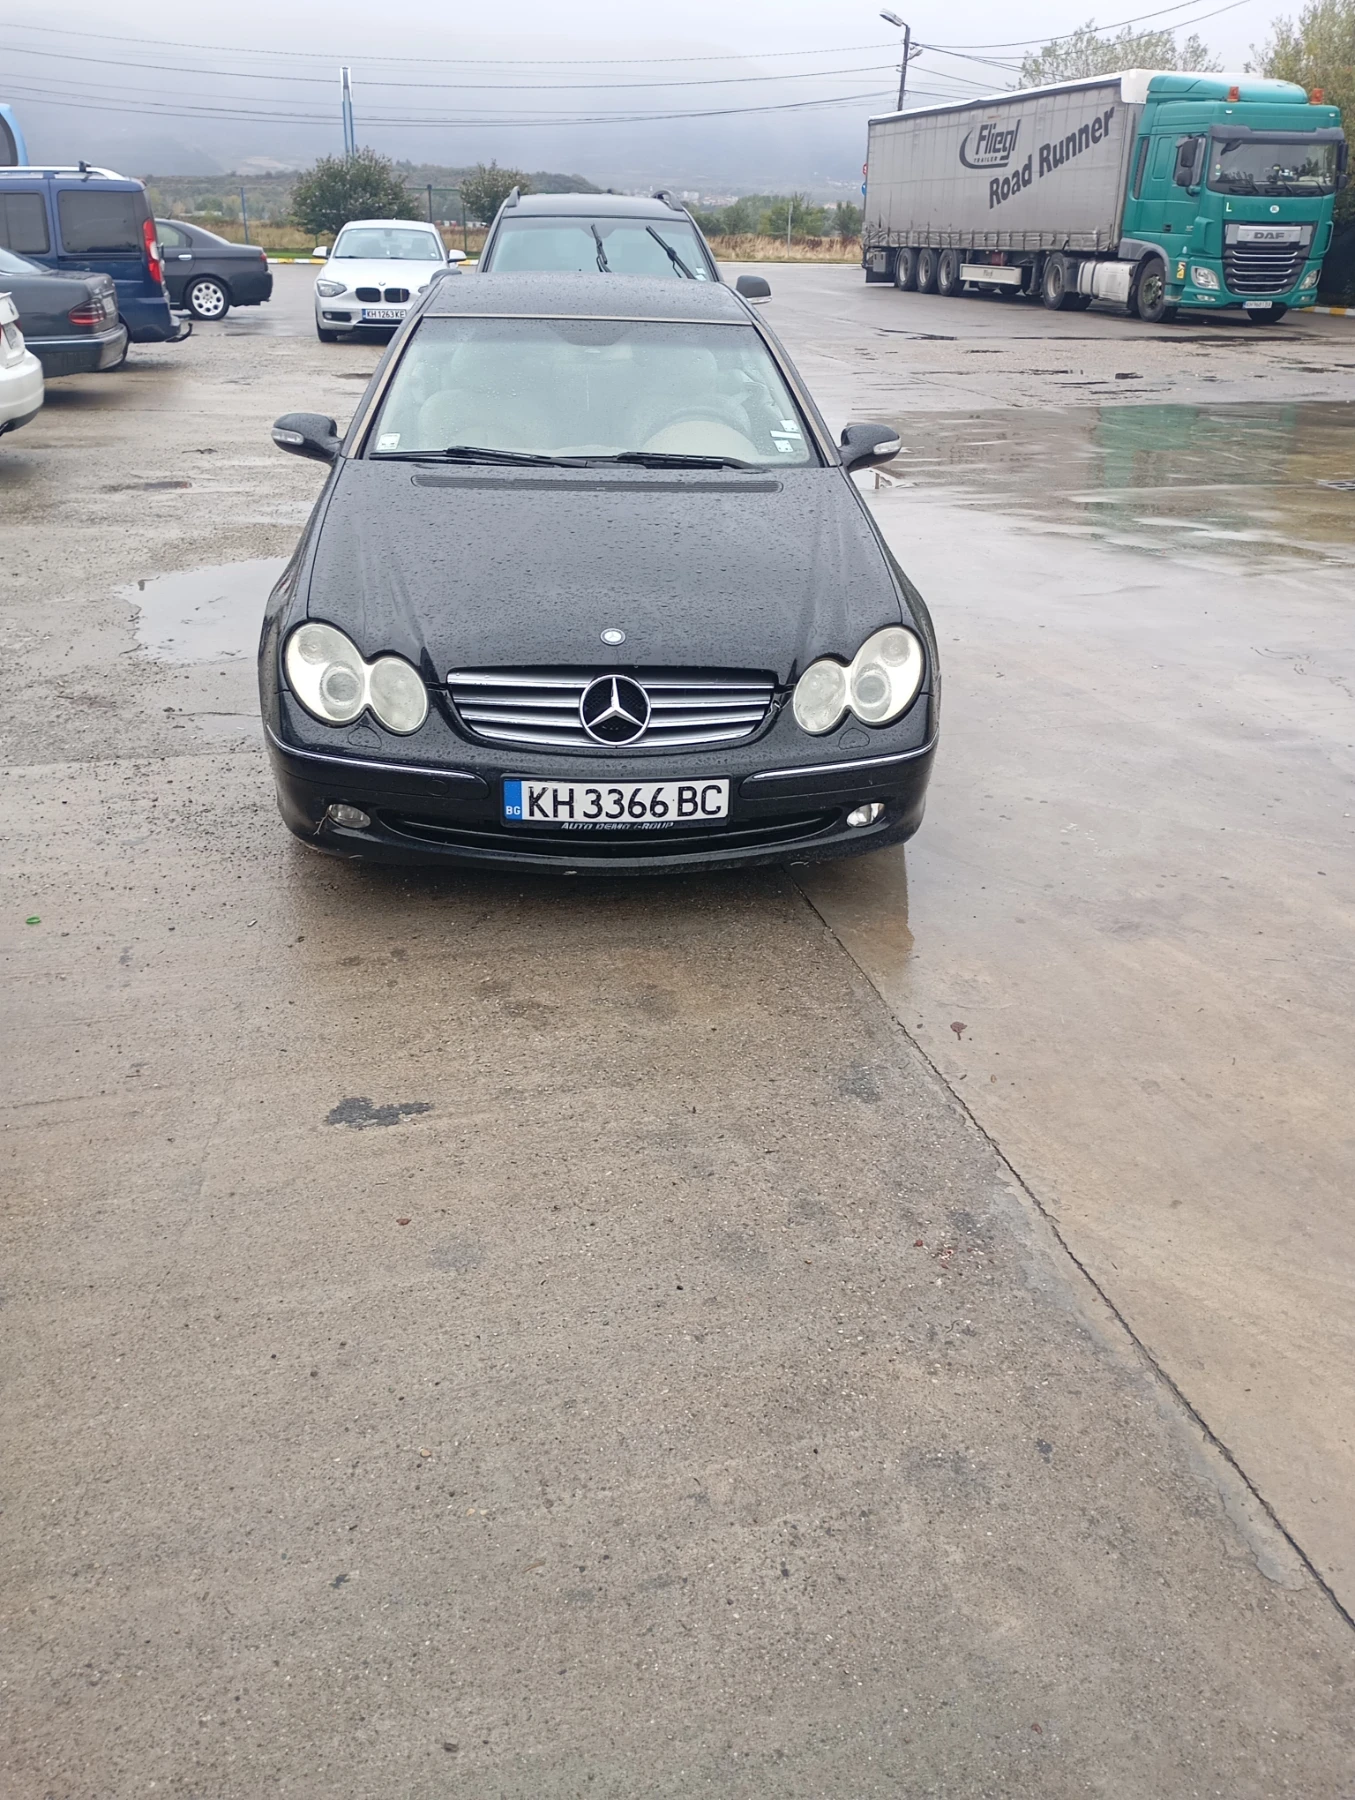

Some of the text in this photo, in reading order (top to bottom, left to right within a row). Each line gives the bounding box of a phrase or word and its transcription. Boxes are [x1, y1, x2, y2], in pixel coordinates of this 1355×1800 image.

[975, 119, 1021, 161] Fliegl
[989, 106, 1115, 210] Road Runner
[1253, 232, 1285, 240] DAF
[505, 805, 521, 816] BG
[561, 822, 593, 830] AUTO
[595, 822, 629, 830] DEMO
